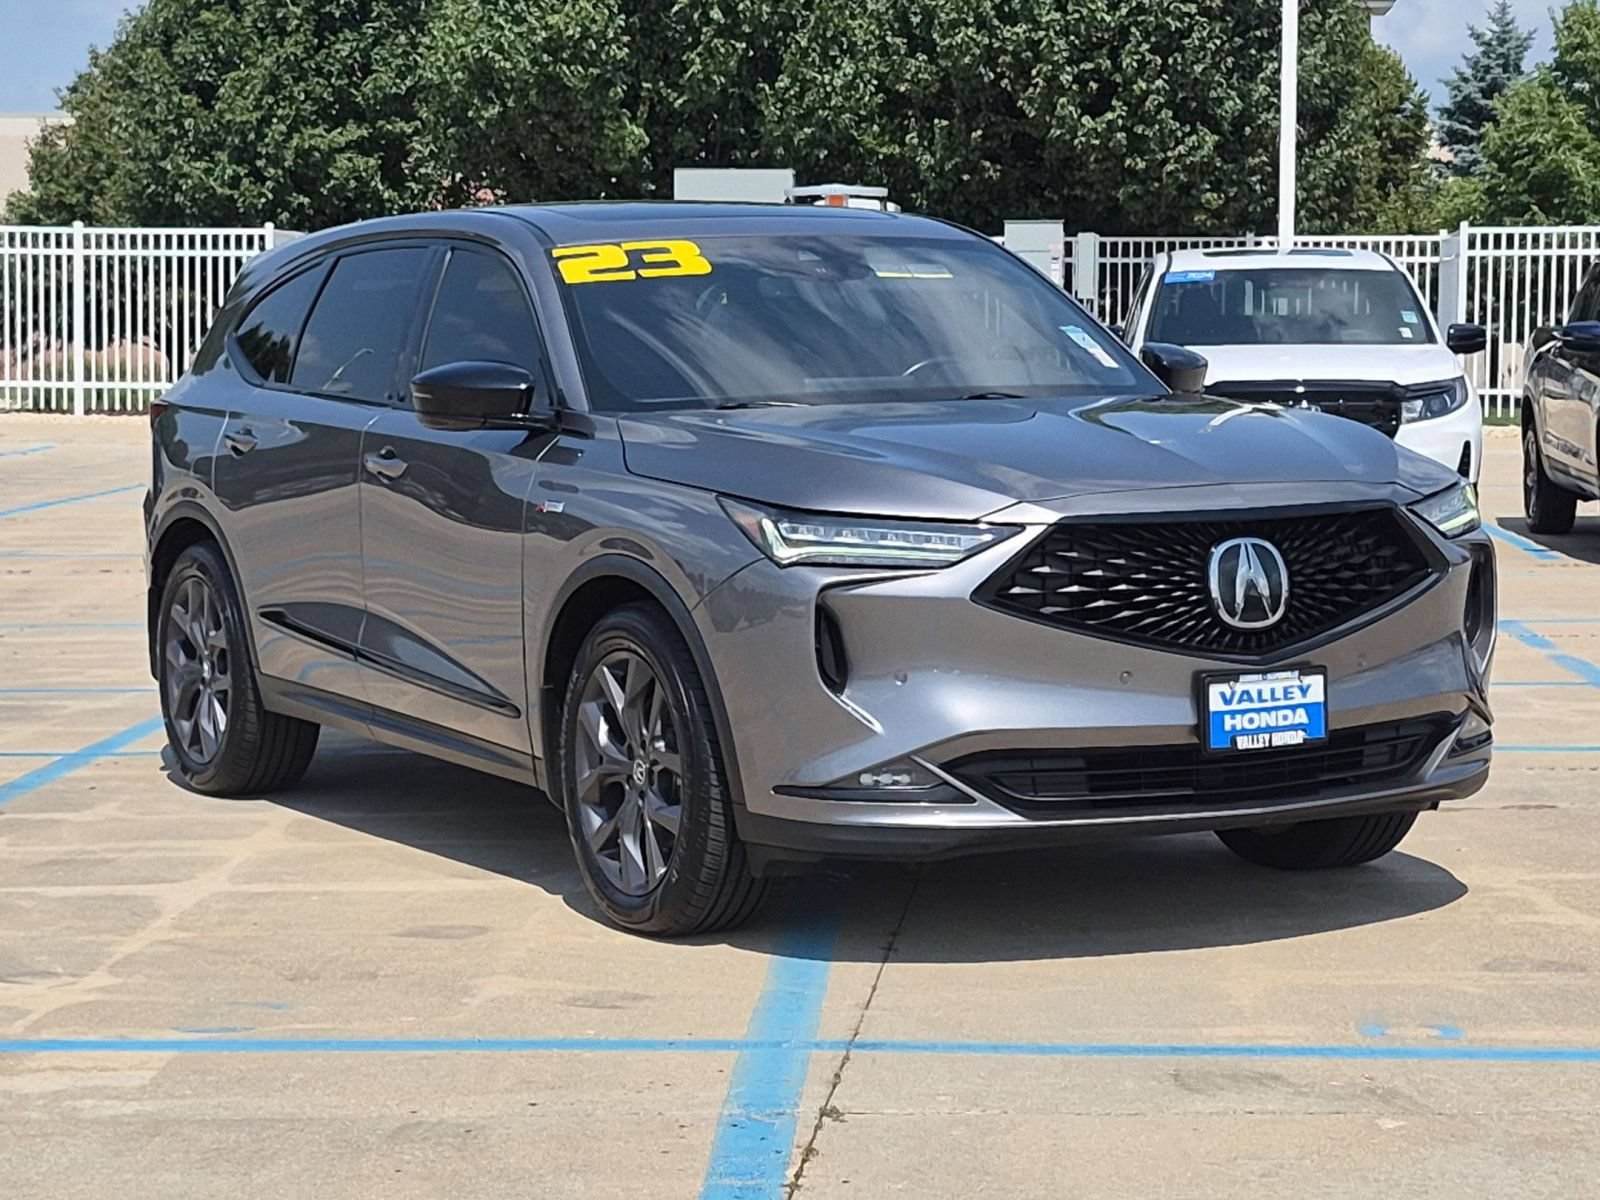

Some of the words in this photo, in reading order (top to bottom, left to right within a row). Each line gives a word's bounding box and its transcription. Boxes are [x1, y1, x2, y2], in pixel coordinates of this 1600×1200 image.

[552, 240, 712, 284] 23
[1219, 684, 1312, 705] VALLEY
[1224, 708, 1309, 731] HONDA
[1236, 733, 1271, 749] VALLEY
